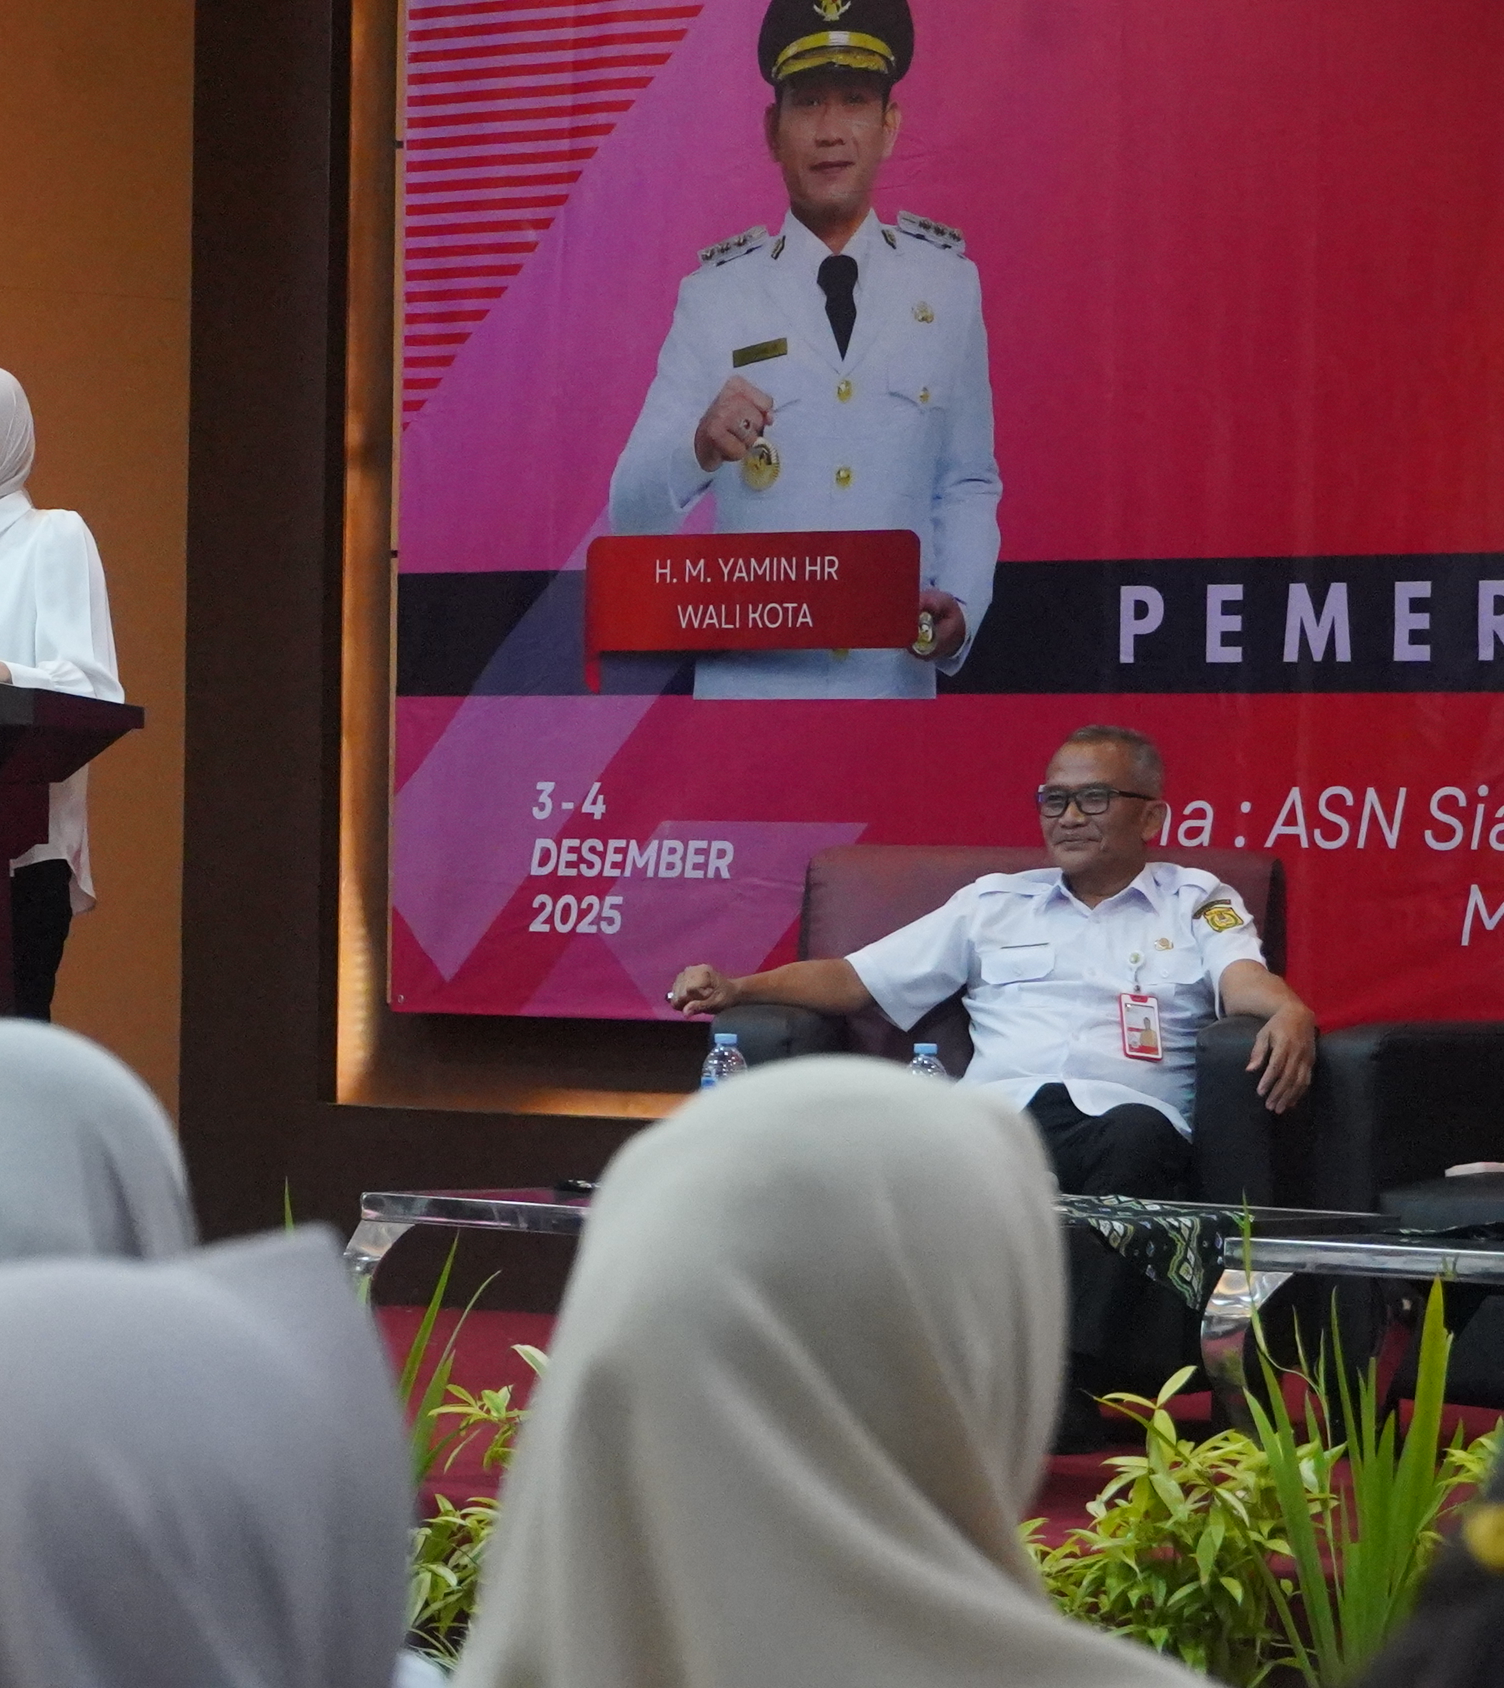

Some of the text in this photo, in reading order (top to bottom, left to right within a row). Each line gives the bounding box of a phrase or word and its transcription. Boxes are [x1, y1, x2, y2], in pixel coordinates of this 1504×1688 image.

[655, 556, 839, 584] H. M. YAMIN HR
[677, 602, 813, 629] WALI KOTA
[1264, 786, 1407, 849] ASN
[530, 838, 734, 879] DESEMBER
[528, 894, 623, 935] 2025
